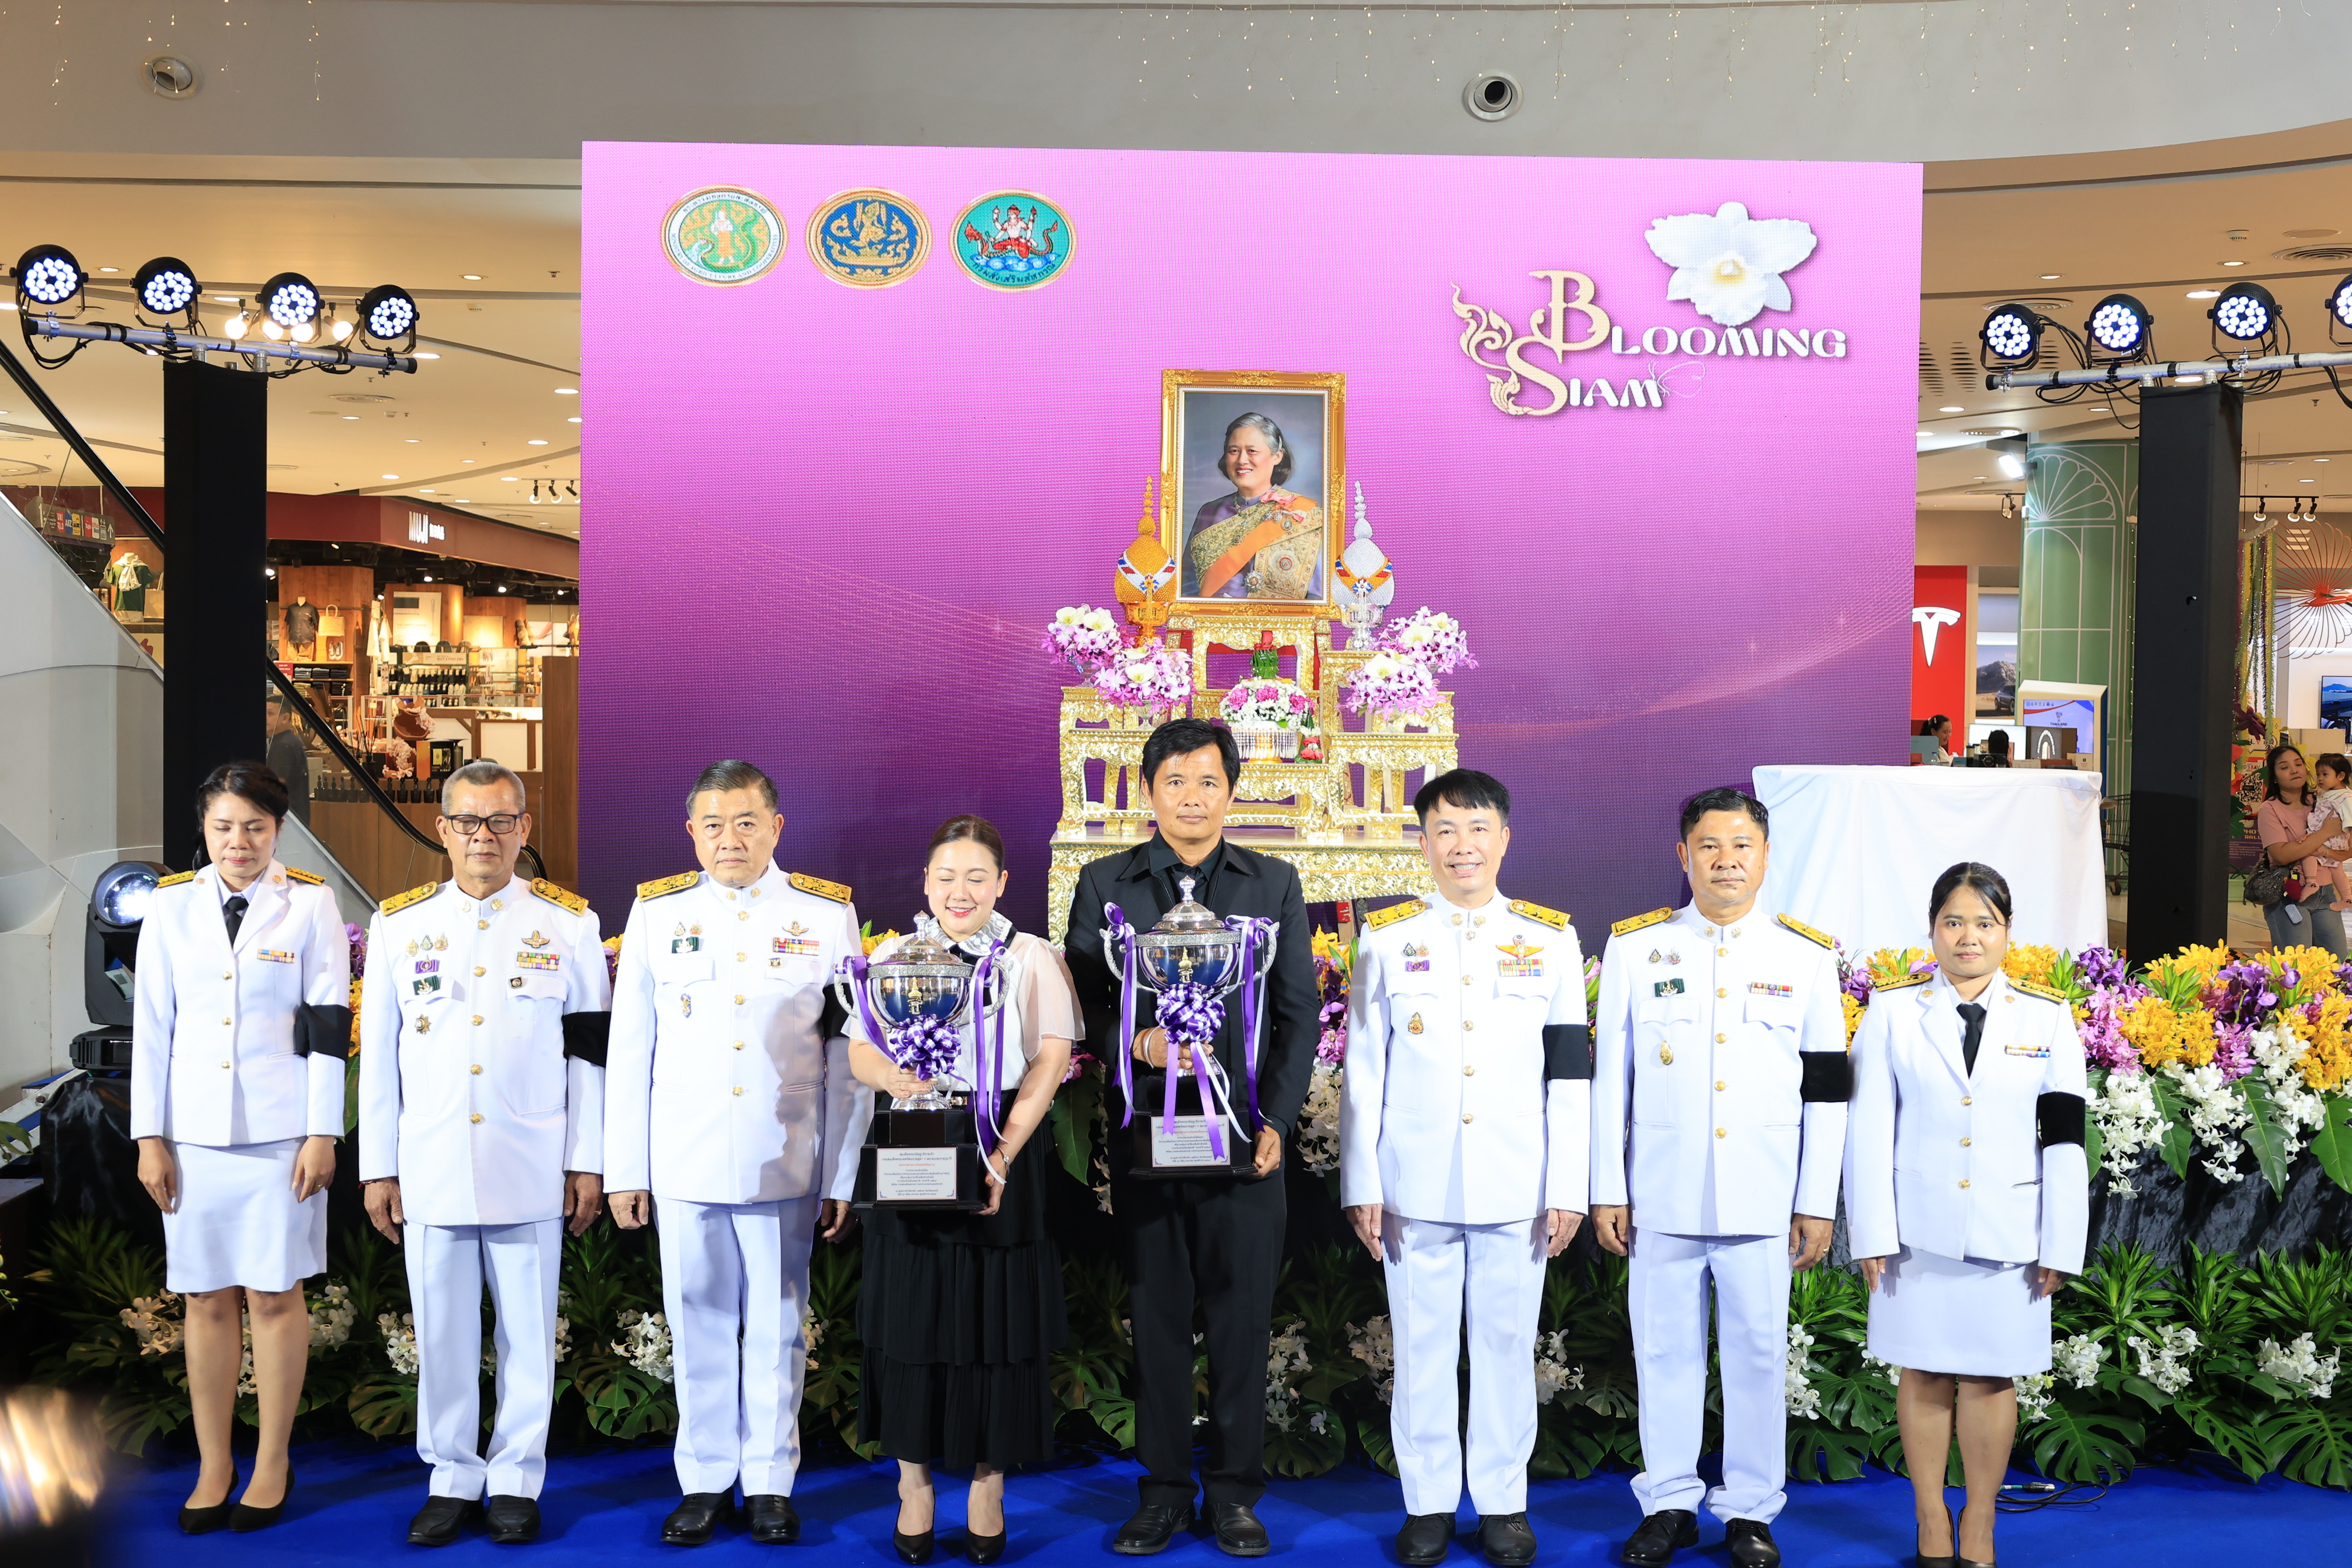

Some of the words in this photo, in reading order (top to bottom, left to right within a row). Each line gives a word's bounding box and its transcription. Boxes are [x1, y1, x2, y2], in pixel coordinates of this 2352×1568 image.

[1529, 270, 1847, 361] BLOOMING
[1487, 334, 1664, 417] SIAM
[409, 511, 429, 544] MUJI
